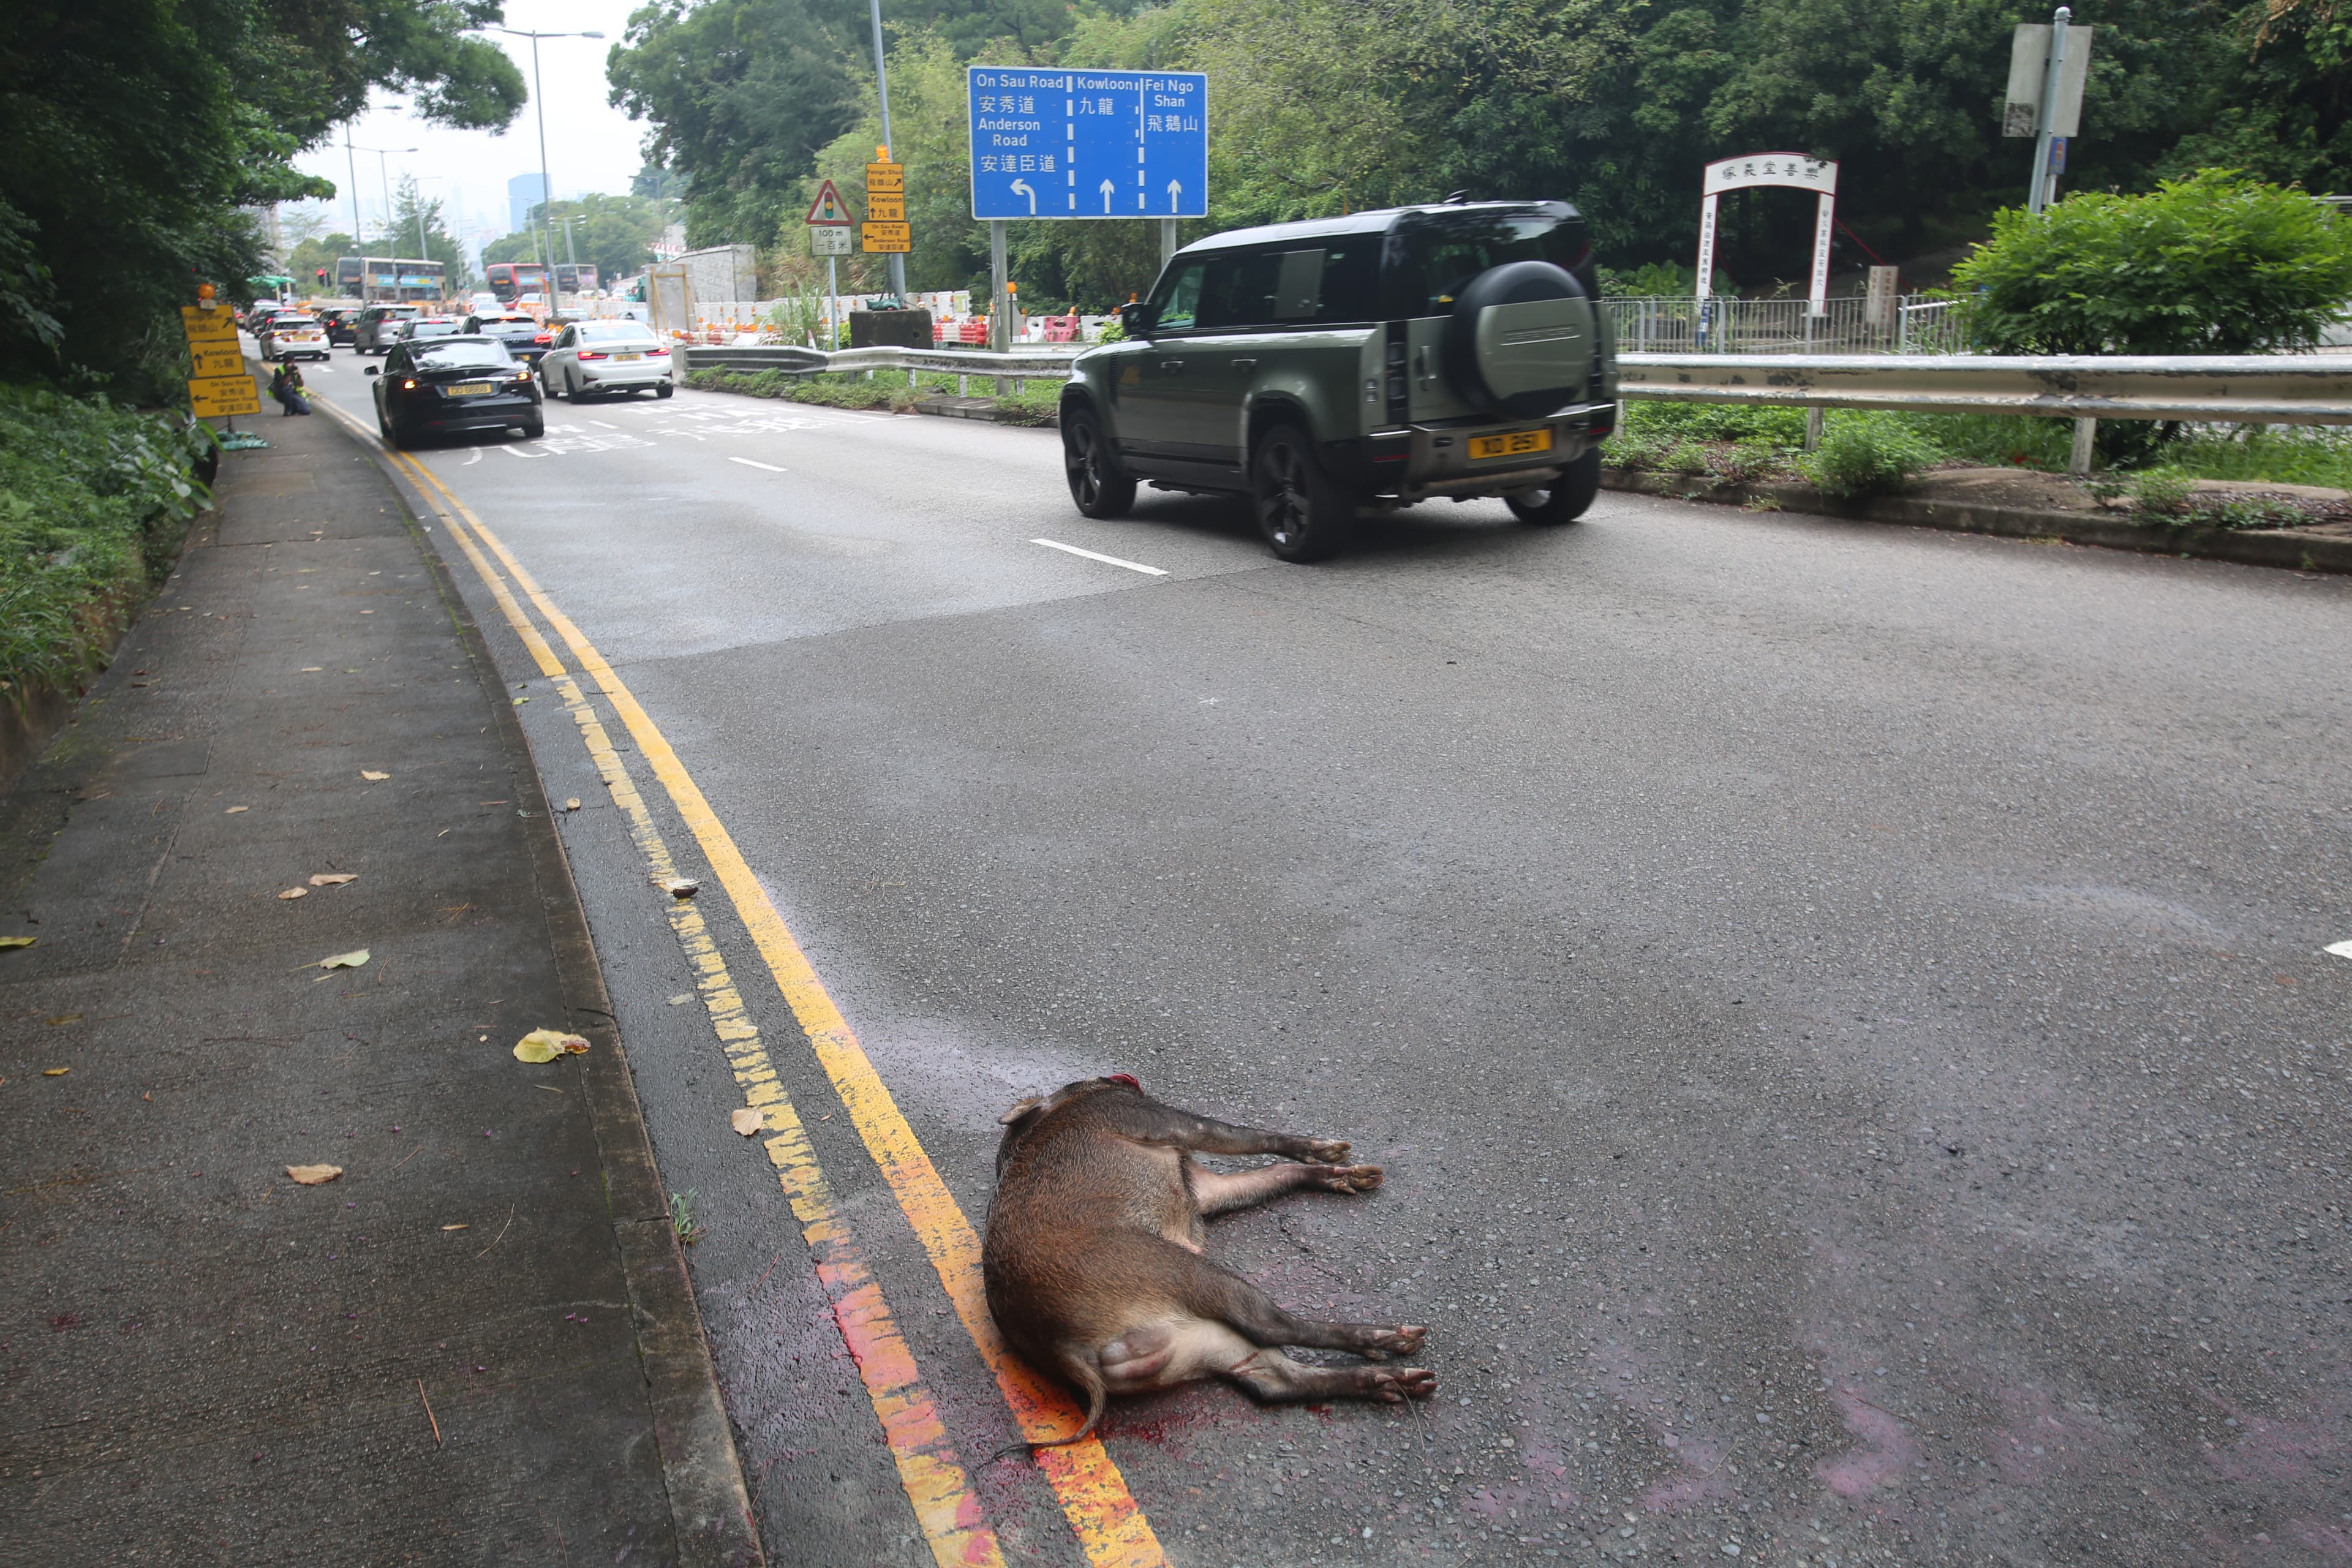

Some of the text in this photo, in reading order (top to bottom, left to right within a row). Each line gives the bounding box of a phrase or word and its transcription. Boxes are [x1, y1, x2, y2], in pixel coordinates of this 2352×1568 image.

[977, 74, 1064, 89] On Sau Road
[1077, 77, 1133, 91] Kowloon
[1145, 78, 1194, 94] Fei Ngo
[979, 96, 1035, 114] 安秀道
[1079, 97, 1114, 115] 九龍
[1154, 94, 1185, 108] Shan
[979, 118, 1040, 130] Anderson
[1147, 115, 1198, 132] 飛鵝山
[993, 134, 1028, 146] Road
[981, 154, 1055, 173] 安達臣道
[816, 241, 848, 251] 一百米
